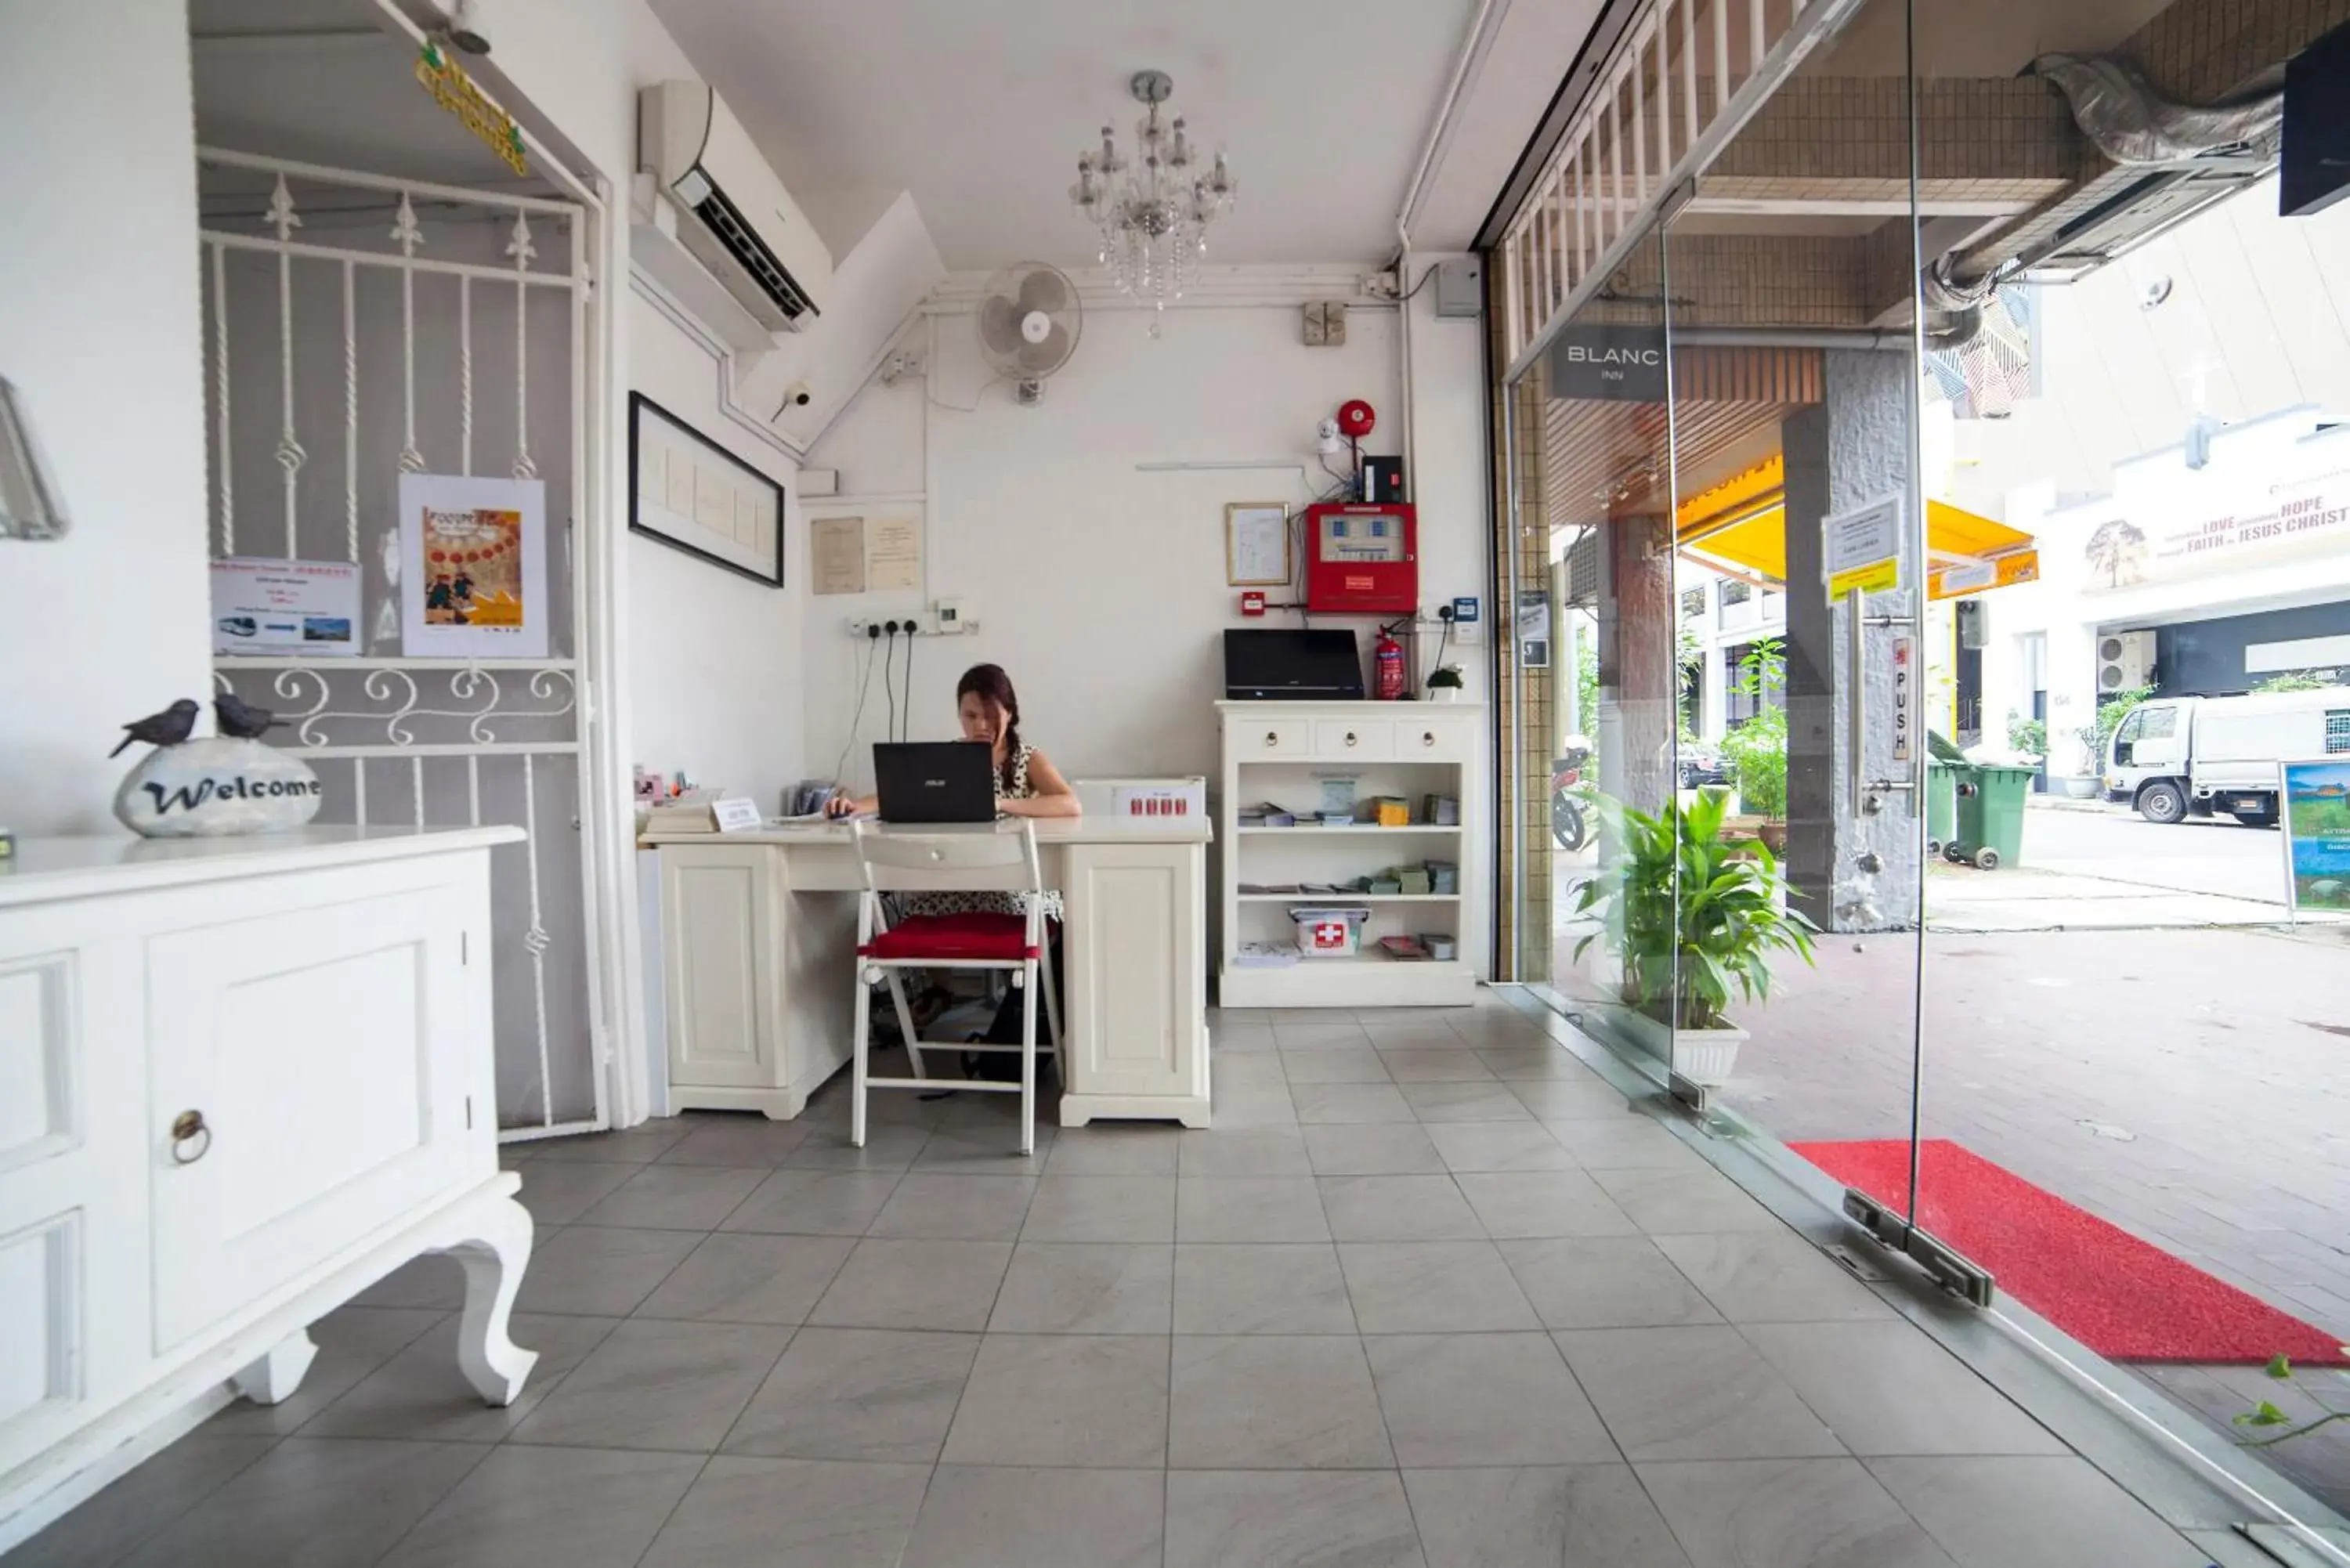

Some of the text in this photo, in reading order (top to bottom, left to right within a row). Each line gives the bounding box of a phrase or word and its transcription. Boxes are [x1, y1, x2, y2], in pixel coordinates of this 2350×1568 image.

[1568, 346, 1659, 365] BLANC
[1601, 370, 1624, 380] INN
[2187, 535, 2224, 552] FAITH
[2239, 522, 2282, 543] JESUS
[2286, 507, 2349, 532] CHRIST
[2203, 516, 2235, 534] LOVE
[2280, 496, 2323, 518] HOPE
[1896, 673, 1906, 750] PUSH
[143, 775, 323, 815] Welcome
